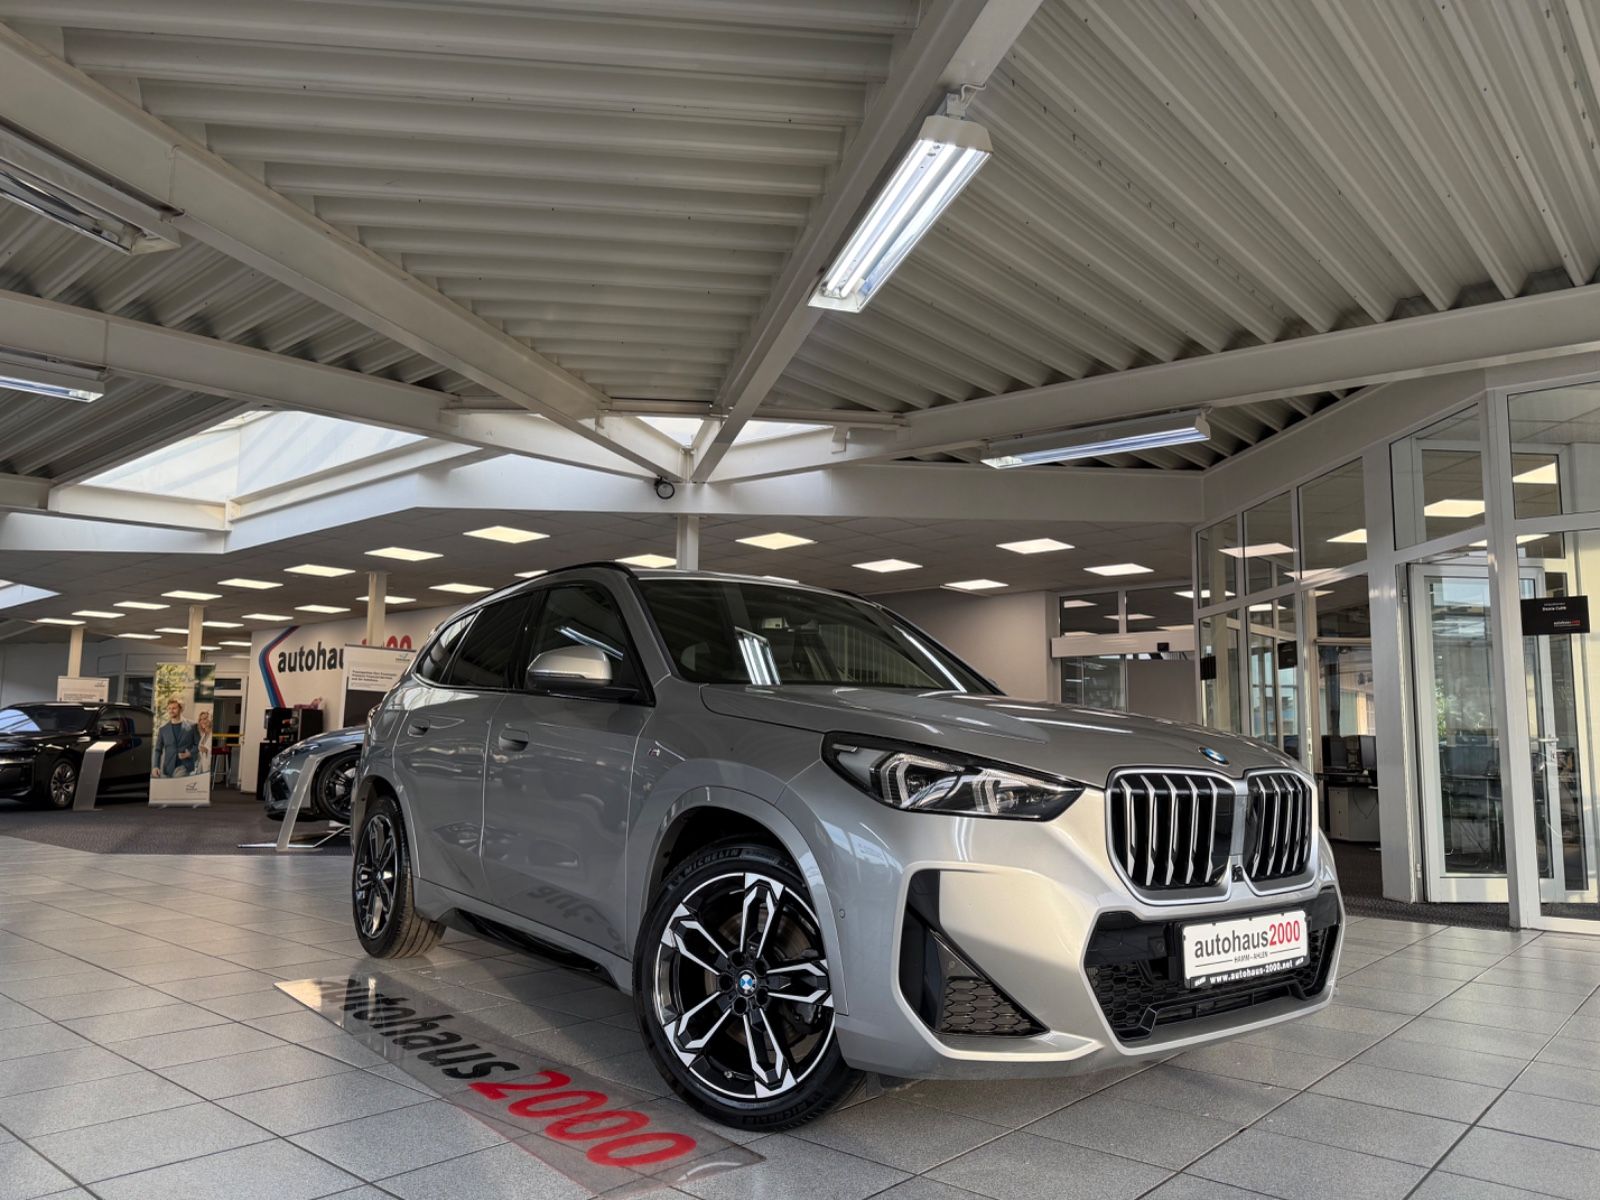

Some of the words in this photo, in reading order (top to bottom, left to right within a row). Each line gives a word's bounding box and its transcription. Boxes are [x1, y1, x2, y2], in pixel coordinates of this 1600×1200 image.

[1194, 920, 1301, 959] autohaus2000
[1209, 960, 1293, 985] www.autohaus-2000.net
[311, 977, 697, 1167] autohaus2000
